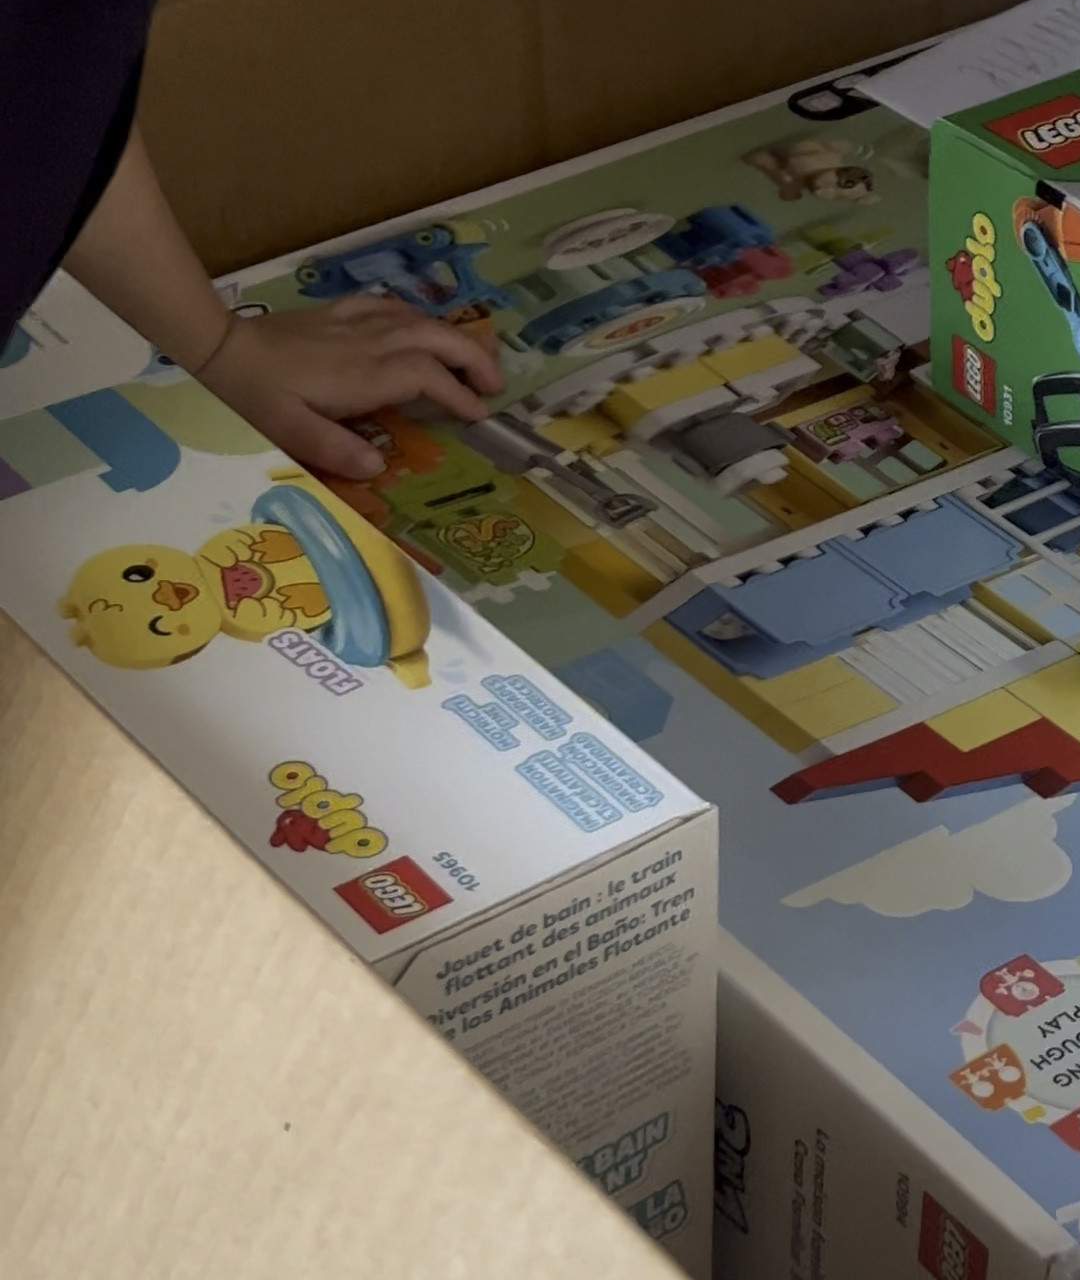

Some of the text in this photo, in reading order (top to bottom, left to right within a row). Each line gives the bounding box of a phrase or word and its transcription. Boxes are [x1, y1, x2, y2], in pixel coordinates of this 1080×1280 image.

[964, 212, 1002, 342] duplo
[964, 344, 985, 402] LEGO
[1002, 384, 1013, 426] 10931
[268, 631, 363, 696] FLOATS
[483, 676, 564, 739] HABILIDADES
[506, 675, 571, 726] MOTRICES
[517, 762, 600, 831] IMAGINATION
[573, 734, 651, 796] CREATIVIDAD
[269, 761, 388, 858] duplo
[361, 873, 427, 917] LEGO
[432, 851, 480, 891] 10965
[436, 939, 504, 979] Jouet
[510, 923, 538, 945] de
[543, 897, 591, 929] bain
[608, 880, 626, 897] le
[631, 850, 682, 884] train
[445, 871, 677, 996] flottant des animaux
[532, 957, 558, 979] en
[564, 941, 581, 963] el
[587, 913, 646, 952] Baño:
[651, 887, 695, 918] Tren
[462, 1009, 493, 1034] los
[499, 956, 599, 1015] Animales
[604, 908, 691, 962] Flotante
[593, 1114, 667, 1175] BAIN
